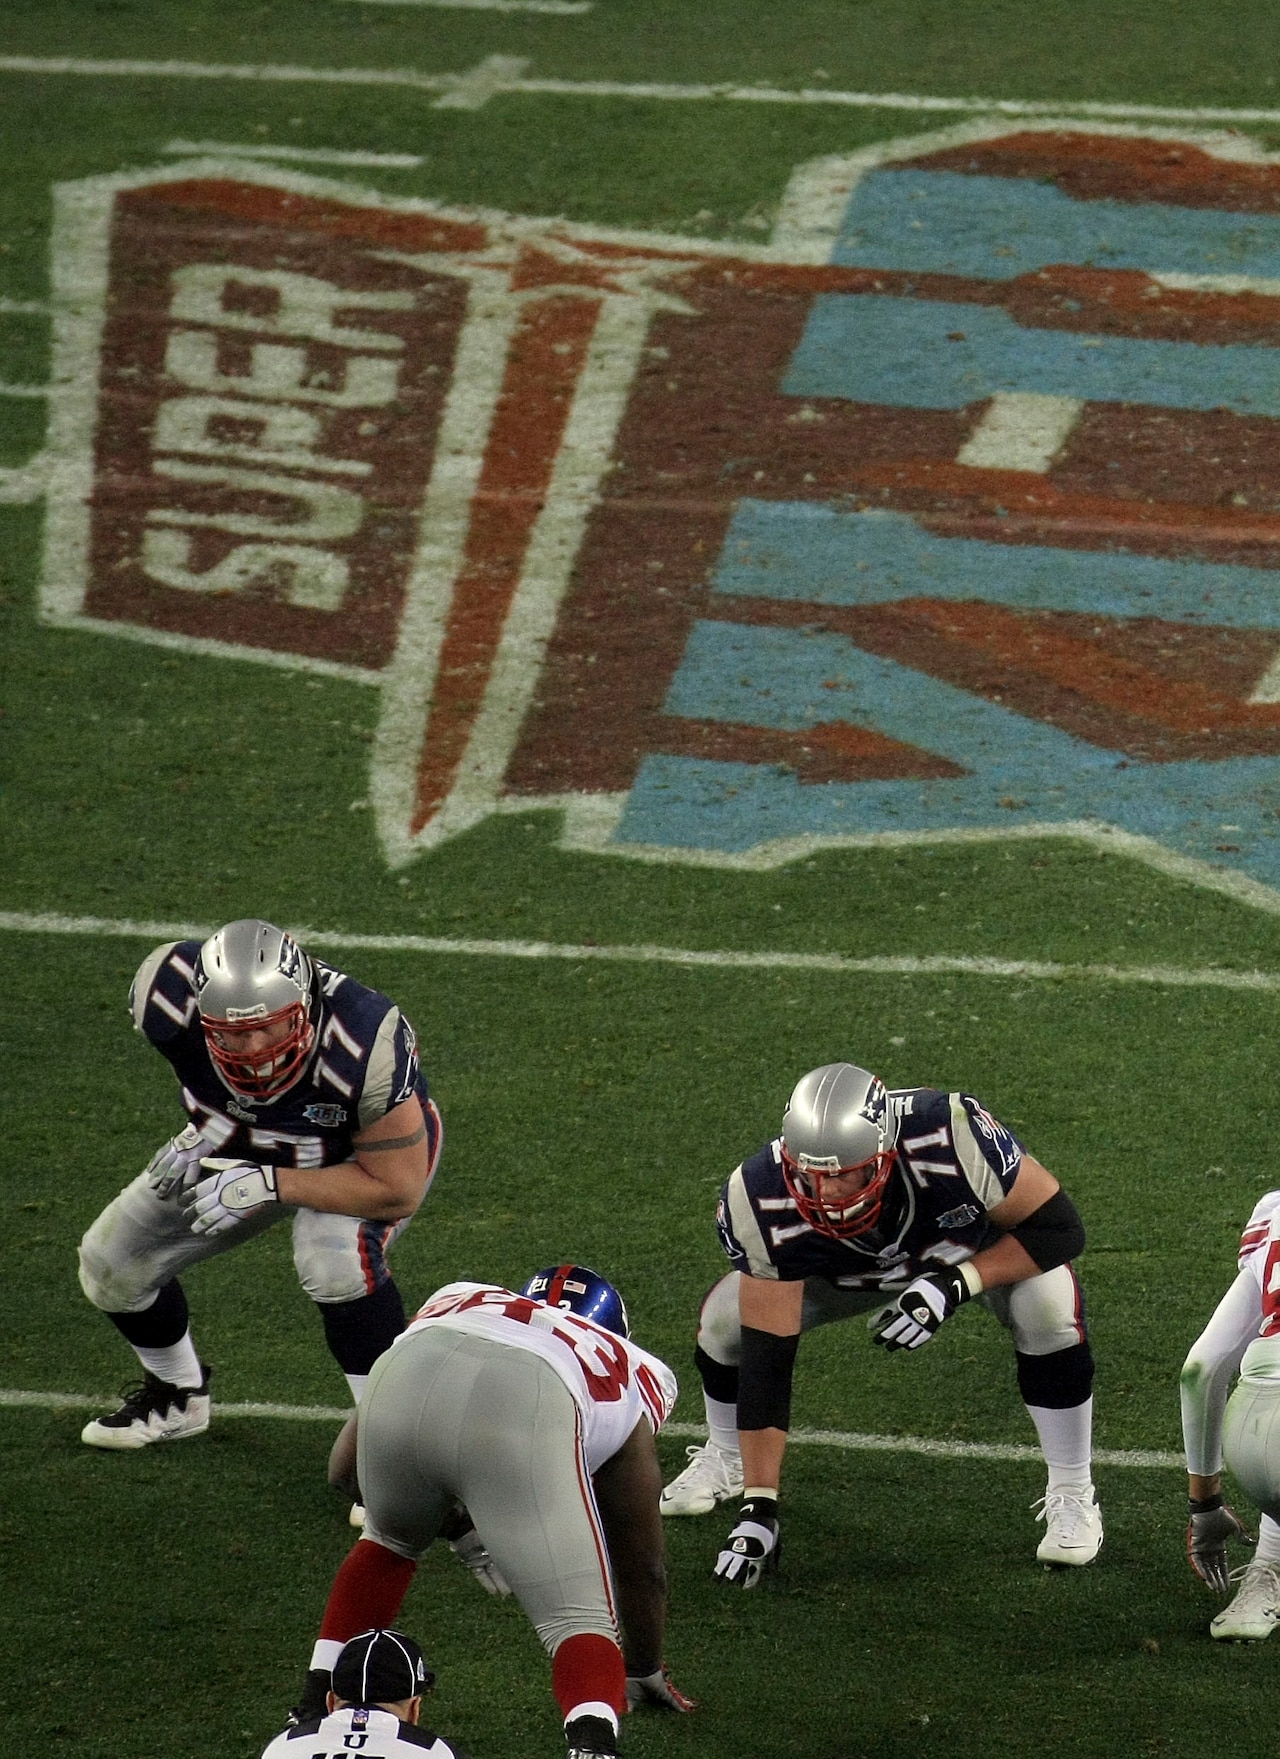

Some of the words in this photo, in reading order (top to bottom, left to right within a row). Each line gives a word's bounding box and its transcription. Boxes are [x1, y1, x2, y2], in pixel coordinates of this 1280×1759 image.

[140, 262, 416, 612] SUPER
[311, 1012, 364, 1099] 77
[902, 1125, 960, 1189] 71
[343, 1734, 369, 1749] U
